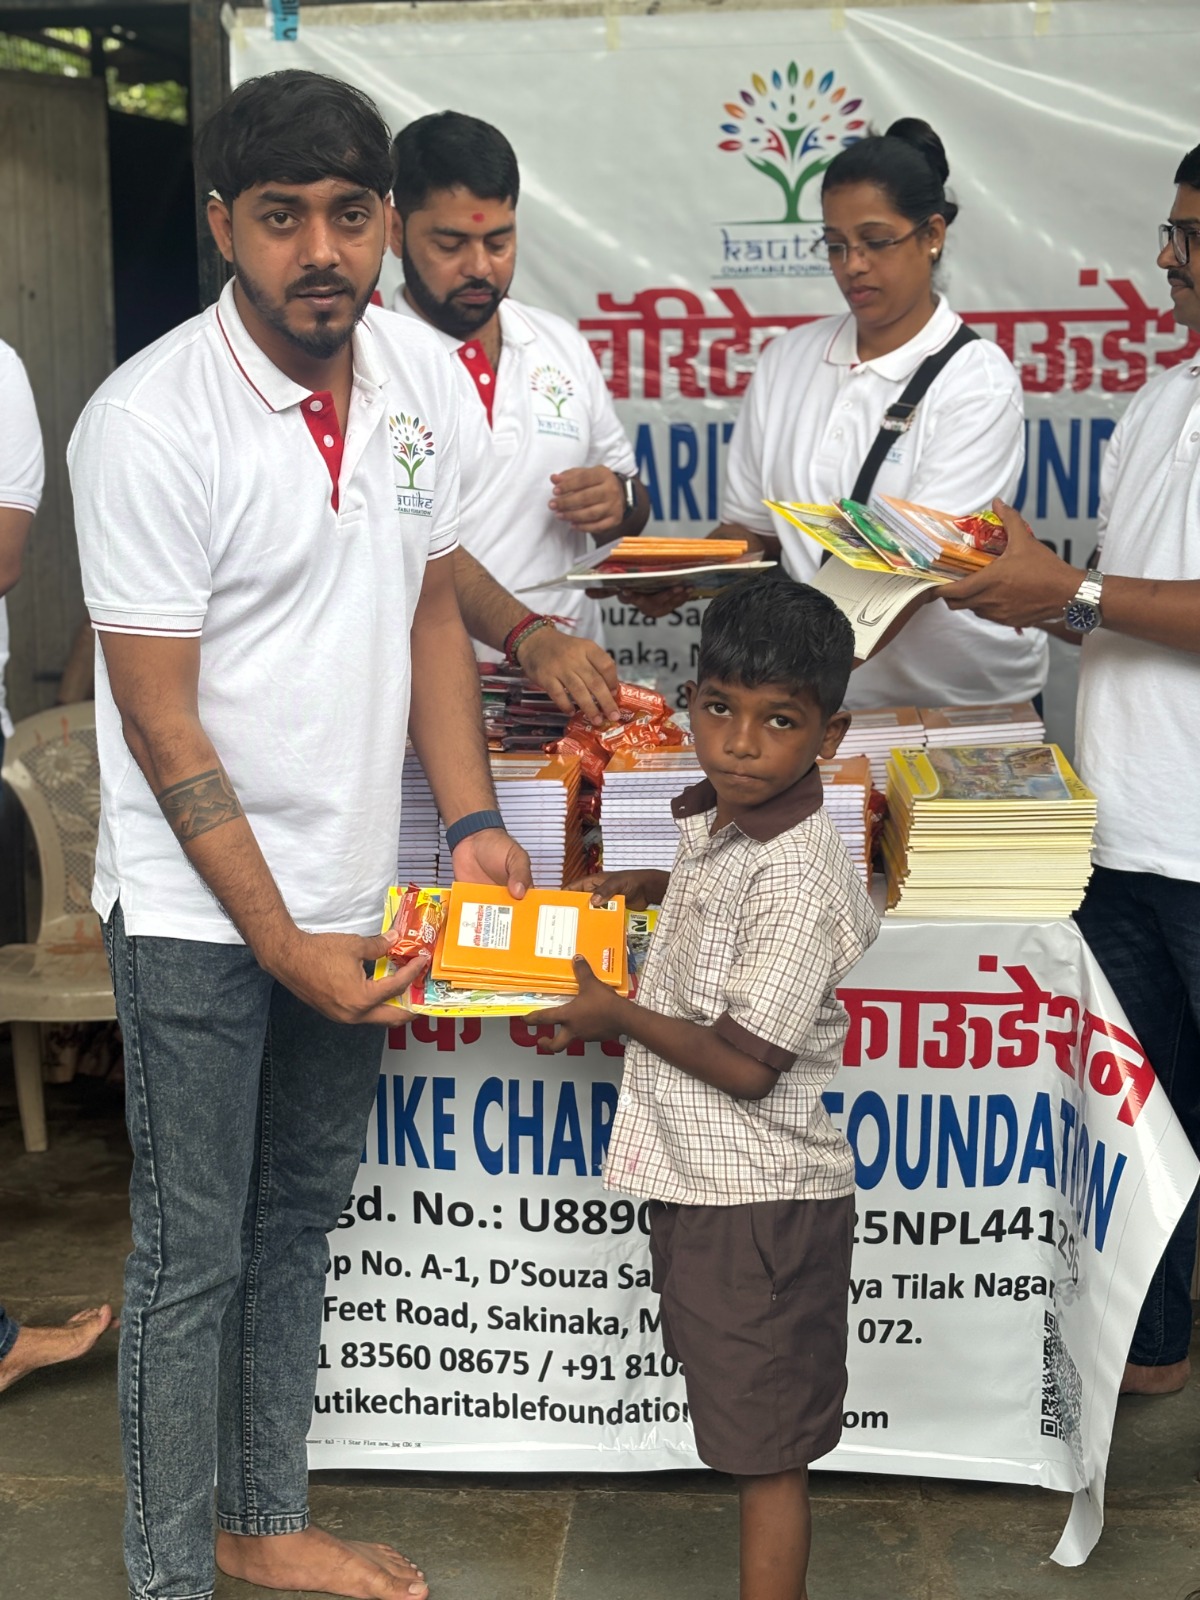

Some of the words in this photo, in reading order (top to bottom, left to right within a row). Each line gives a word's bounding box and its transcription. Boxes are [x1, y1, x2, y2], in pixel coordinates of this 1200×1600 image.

[473, 1076, 620, 1176] CHAR
[413, 1190, 502, 1230] No.:
[362, 1250, 411, 1278] No.
[421, 1253, 479, 1288] A-1,
[617, 1262, 651, 1290] Sa
[849, 1278, 882, 1304] ya
[892, 1273, 965, 1300] Tilak
[323, 1296, 387, 1323] Feet
[396, 1298, 478, 1334] Road,
[487, 1305, 629, 1340] Sakinaka,
[857, 1318, 922, 1344] 072.
[317, 1344, 331, 1369] 1
[340, 1341, 431, 1370] 83560
[439, 1347, 529, 1375] 08675
[562, 1354, 615, 1381] +91
[842, 1410, 889, 1429] om
